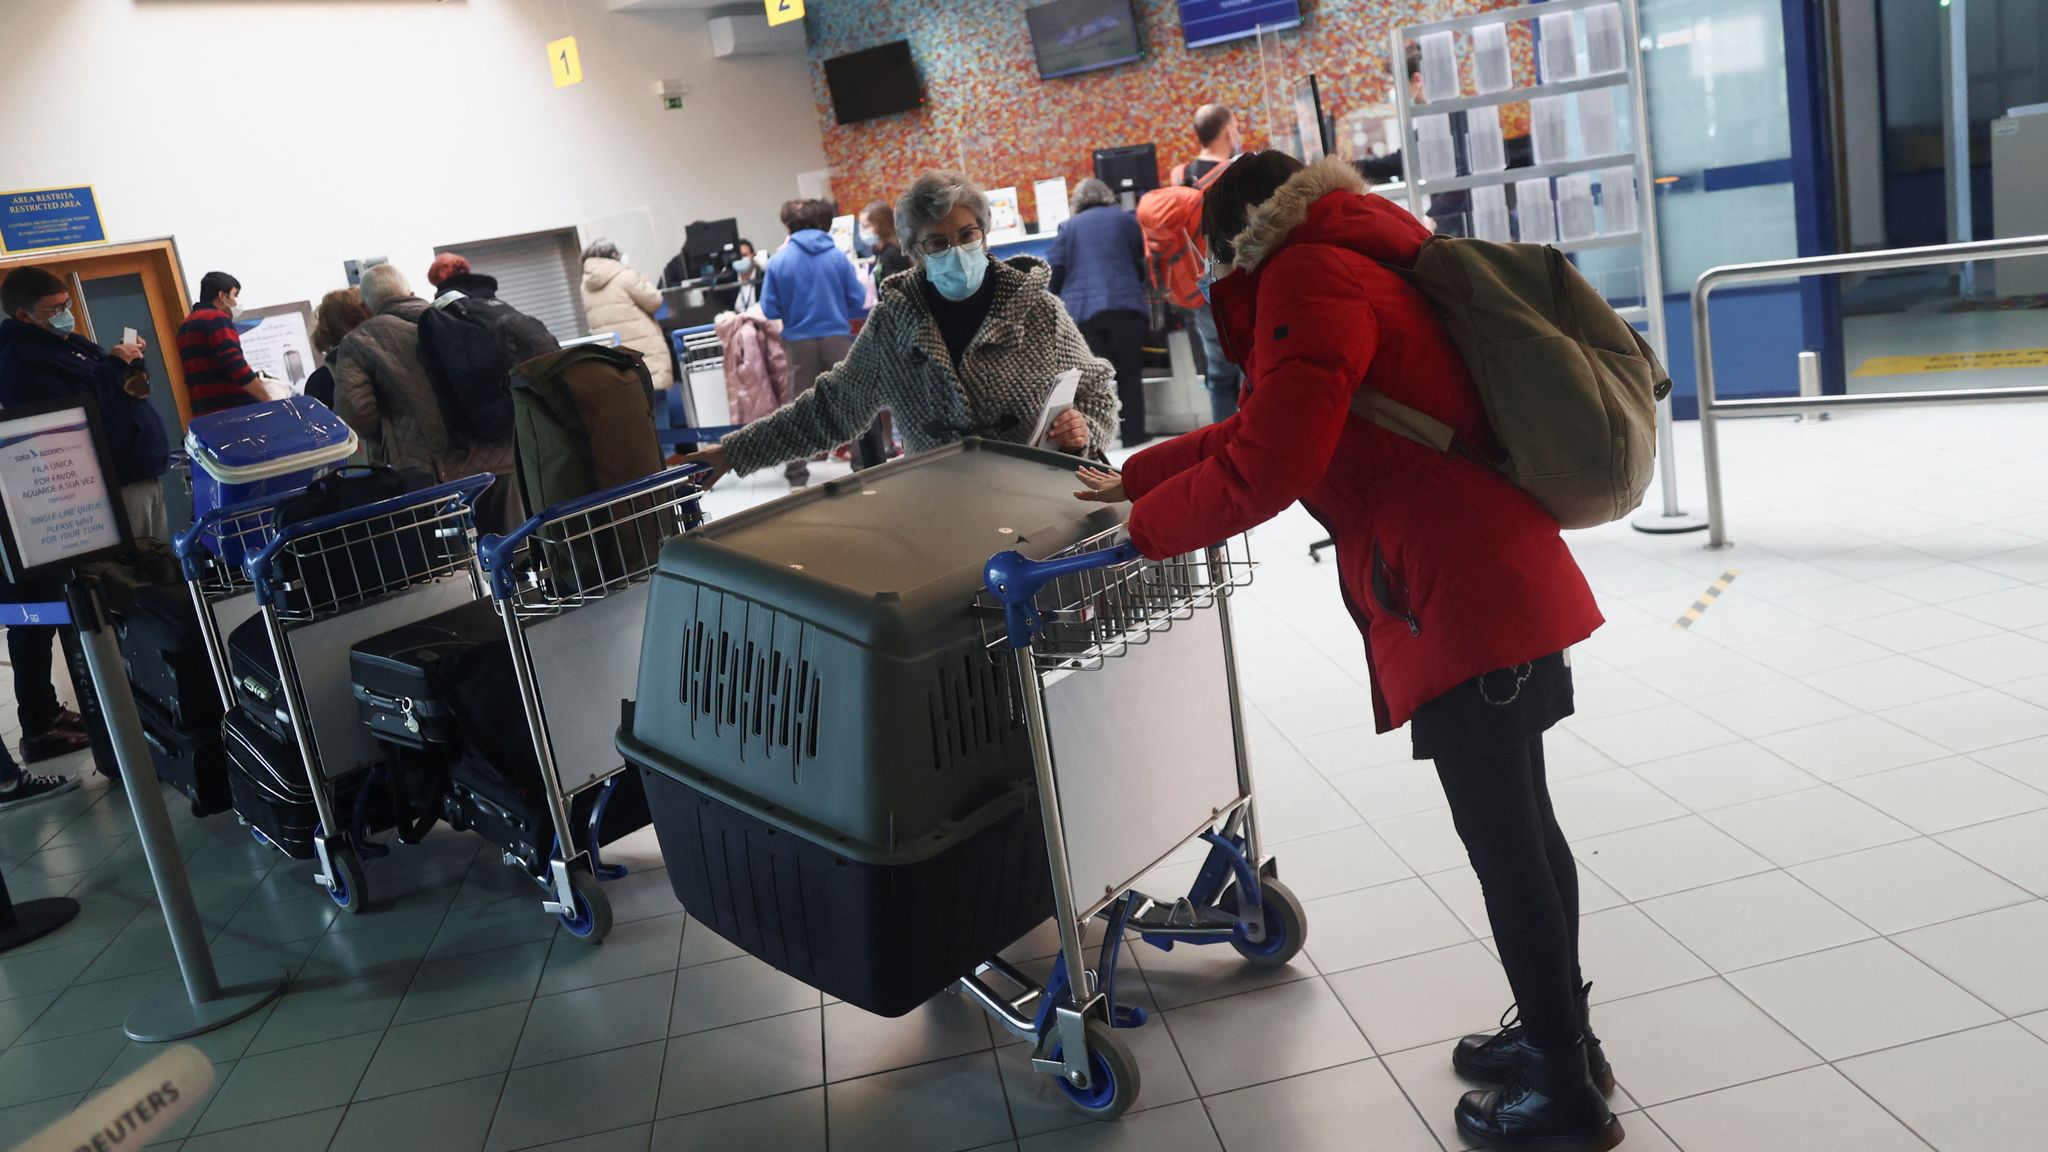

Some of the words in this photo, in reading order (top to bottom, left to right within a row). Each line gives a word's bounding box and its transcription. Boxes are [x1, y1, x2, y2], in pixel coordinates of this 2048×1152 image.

[560, 49, 570, 75] 1
[37, 192, 75, 202] RESTRITA
[9, 203, 59, 213] RESTRICTED
[59, 200, 82, 208] AREA
[32, 463, 49, 474] FILA
[34, 476, 50, 486] POR
[51, 470, 76, 482] FAVOR
[22, 484, 57, 499] AGUARDE
[65, 480, 80, 490] SUA
[81, 475, 96, 486] VEZ
[77, 502, 103, 515] QUEUE
[46, 520, 74, 534] PLEASE
[75, 516, 94, 527] WAIT
[41, 535, 58, 545] FOR
[60, 528, 81, 541] YOUR
[83, 523, 104, 535] TURN
